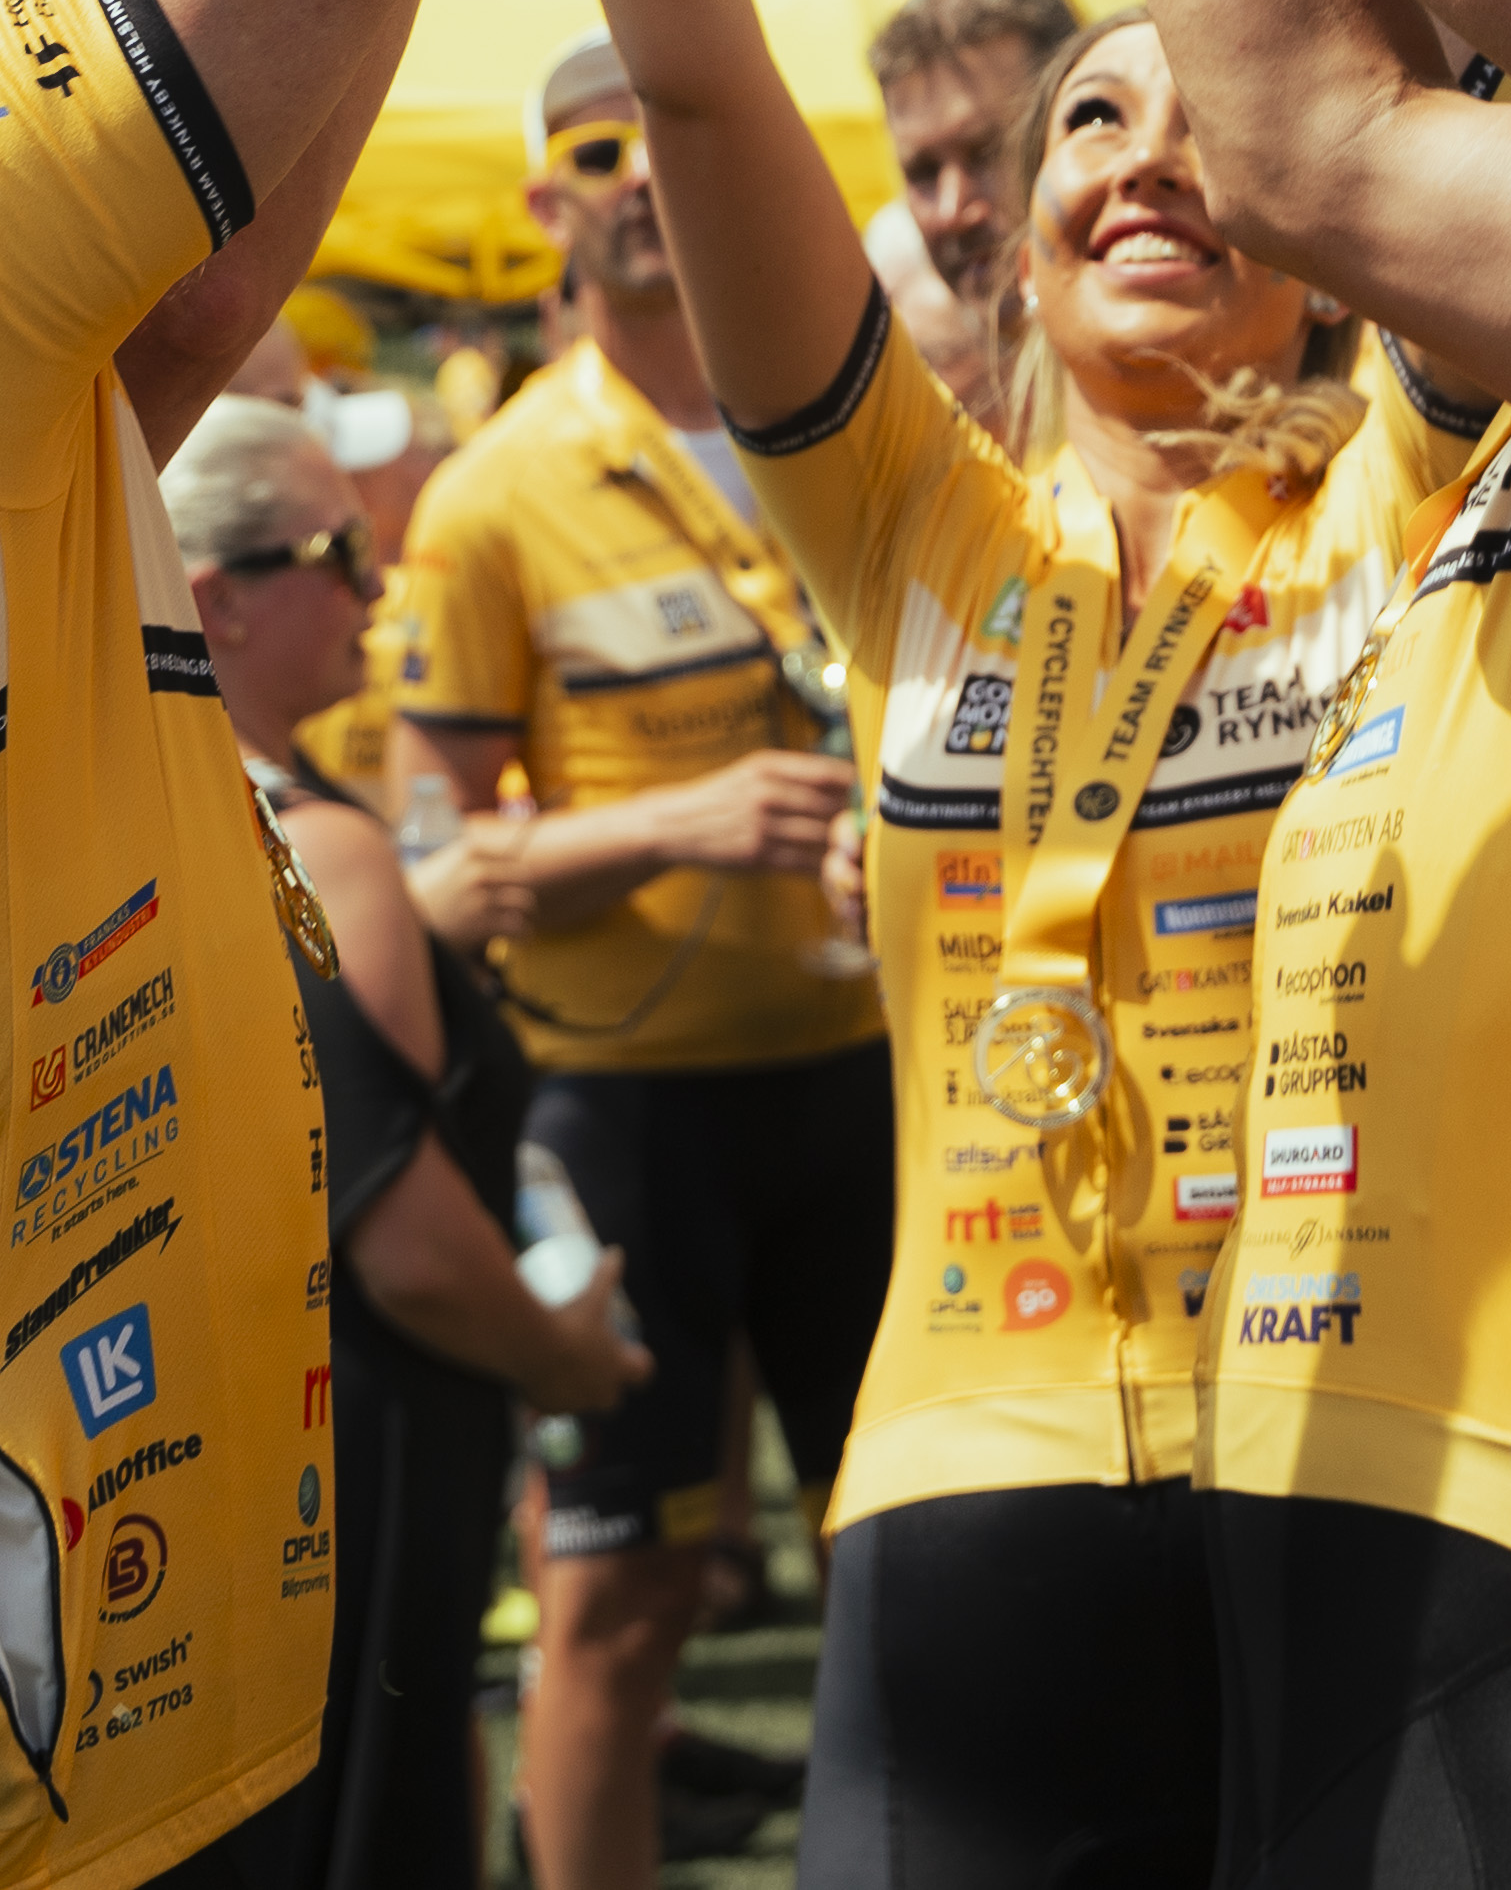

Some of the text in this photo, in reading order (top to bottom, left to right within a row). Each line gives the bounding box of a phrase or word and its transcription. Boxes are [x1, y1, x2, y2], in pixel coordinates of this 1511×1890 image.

[144, 77, 204, 173] RYNKEBY
[198, 171, 226, 221] TEAM
[1102, 555, 1225, 765] TEAM RYNKEBY
[1217, 691, 1340, 747] RYNK
[1327, 883, 1395, 919] Kakel
[1284, 960, 1367, 998] ecophon
[72, 966, 175, 1070] CRANEMECH
[1281, 1030, 1349, 1065] BÅSTAD
[1279, 1063, 1368, 1098] GRUPPEN
[55, 1063, 179, 1183] STENA
[10, 1116, 180, 1250] RECYCLING
[64, 1197, 106, 1235] starts
[106, 1179, 140, 1209] here.
[1243, 1270, 1362, 1304] ÖRESUNDS
[1238, 1303, 1363, 1346] KRAFT
[77, 1321, 144, 1420] LK
[146, 1683, 194, 1719] 7703
